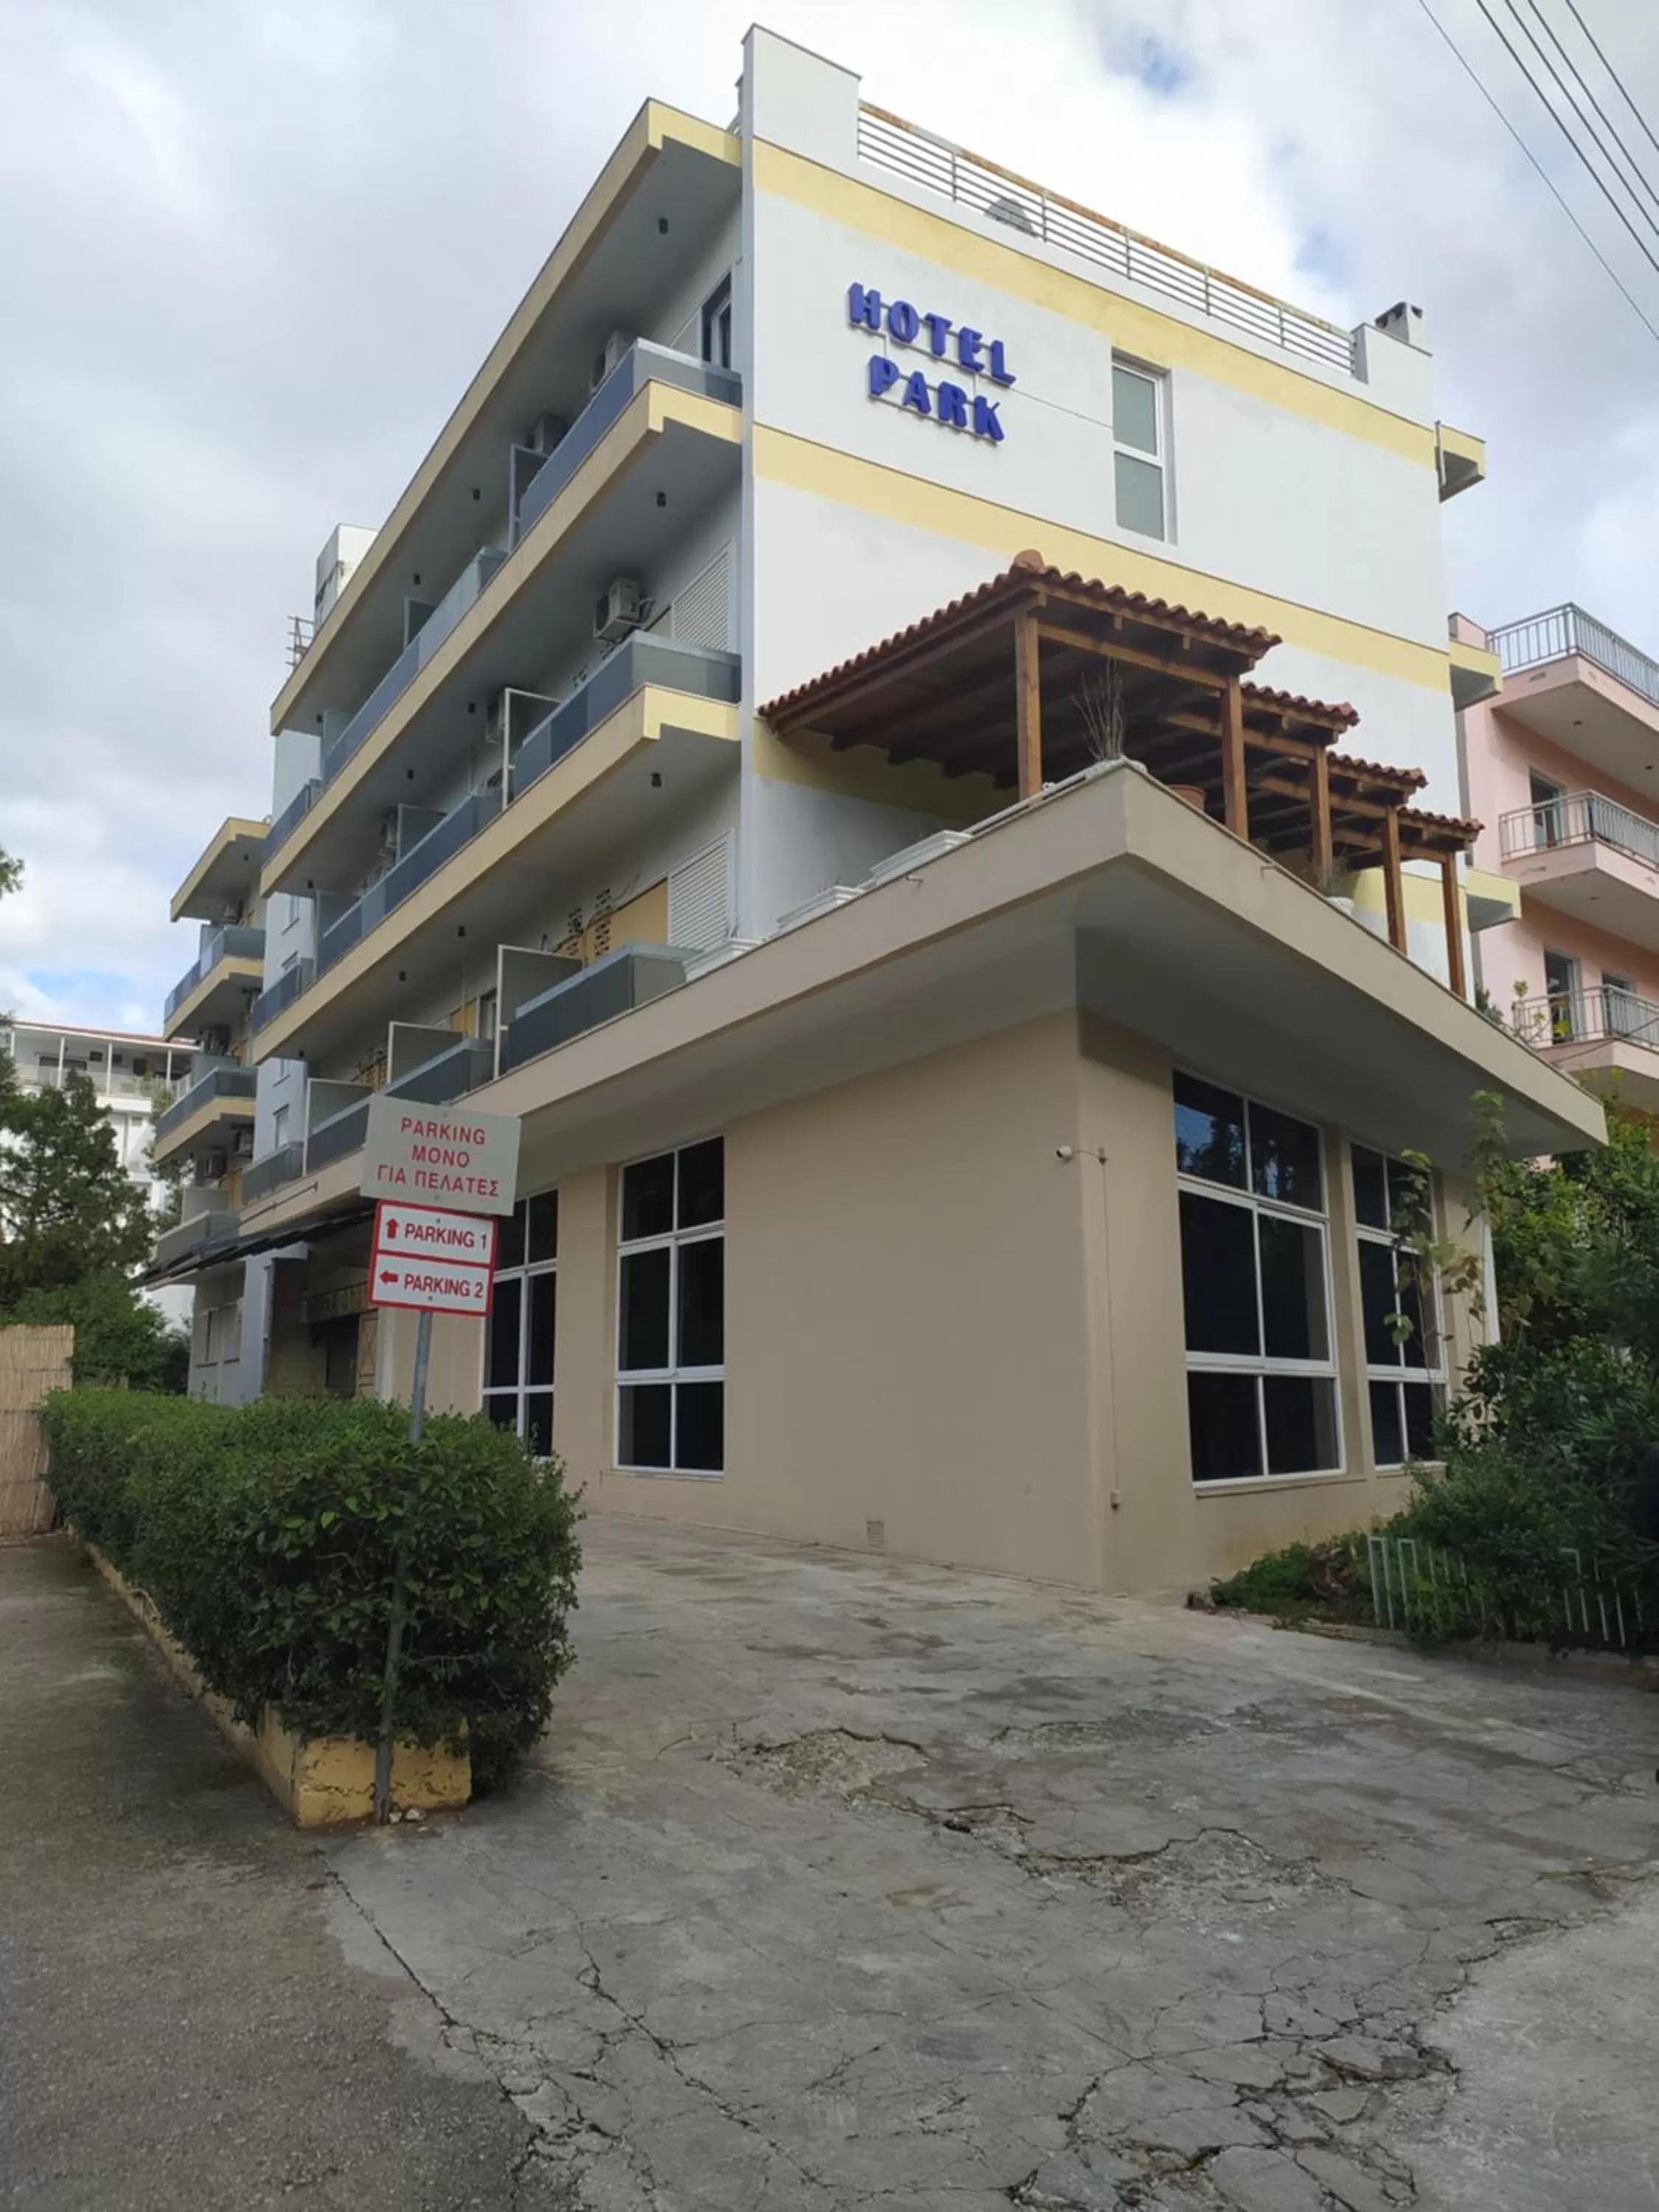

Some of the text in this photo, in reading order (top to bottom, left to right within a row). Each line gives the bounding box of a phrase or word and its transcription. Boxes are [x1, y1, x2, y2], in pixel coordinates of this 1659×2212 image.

[848, 282, 1016, 386] HOTEL
[868, 355, 1004, 442] PARK
[400, 1116, 486, 1145] PARKING
[378, 1164, 499, 1197] ΓΙΑ ΠΕΛΑΤΕΣ
[404, 1222, 487, 1250] PARKING 1
[404, 1273, 484, 1298] PARKING 2
